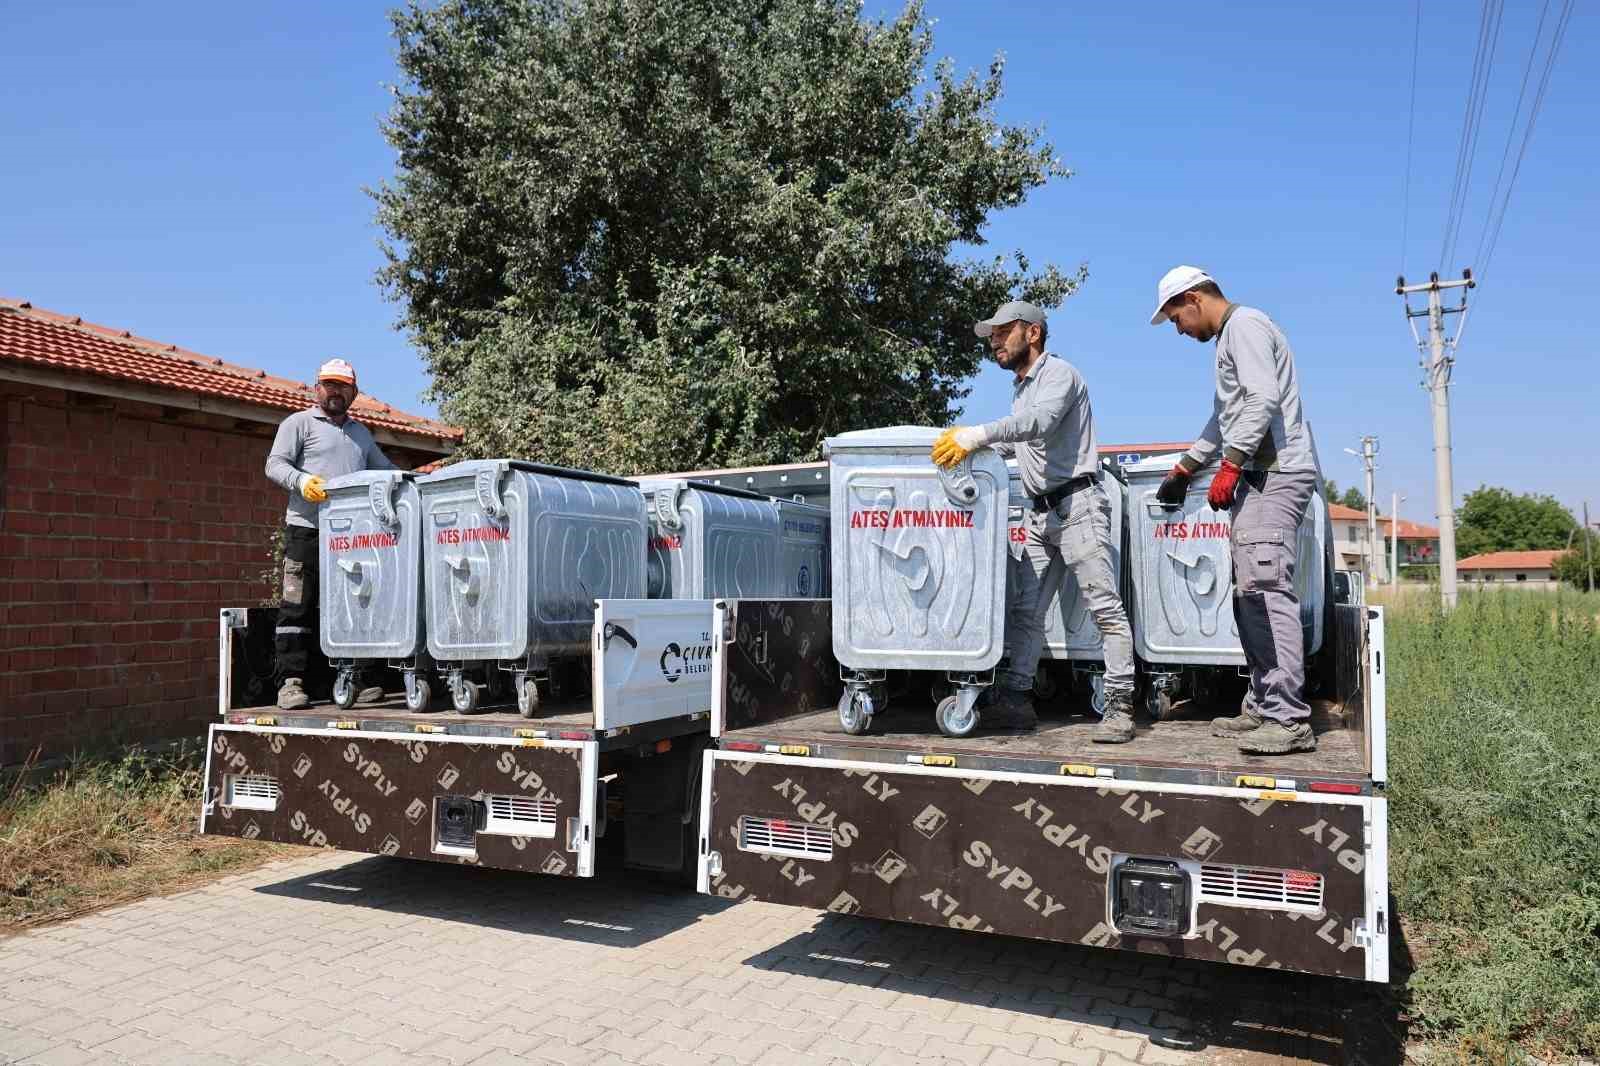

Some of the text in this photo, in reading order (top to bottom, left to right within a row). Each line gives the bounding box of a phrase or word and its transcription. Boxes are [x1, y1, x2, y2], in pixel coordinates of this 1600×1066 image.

[437, 526, 511, 545] ATEŞ ATMAYINIZ
[851, 510, 974, 530] ATEŞ ATMAYINIZ
[1008, 527, 1026, 544] EŞ
[1154, 522, 1188, 541] ATEŞ
[329, 532, 399, 552] ATEŞ ATMAYINIZ
[343, 743, 397, 796] SYPLY
[318, 779, 371, 834] SYPLY
[773, 777, 859, 848] SYPLY
[1012, 798, 1111, 874] SYPLY
[963, 841, 1066, 917] SYPLY
